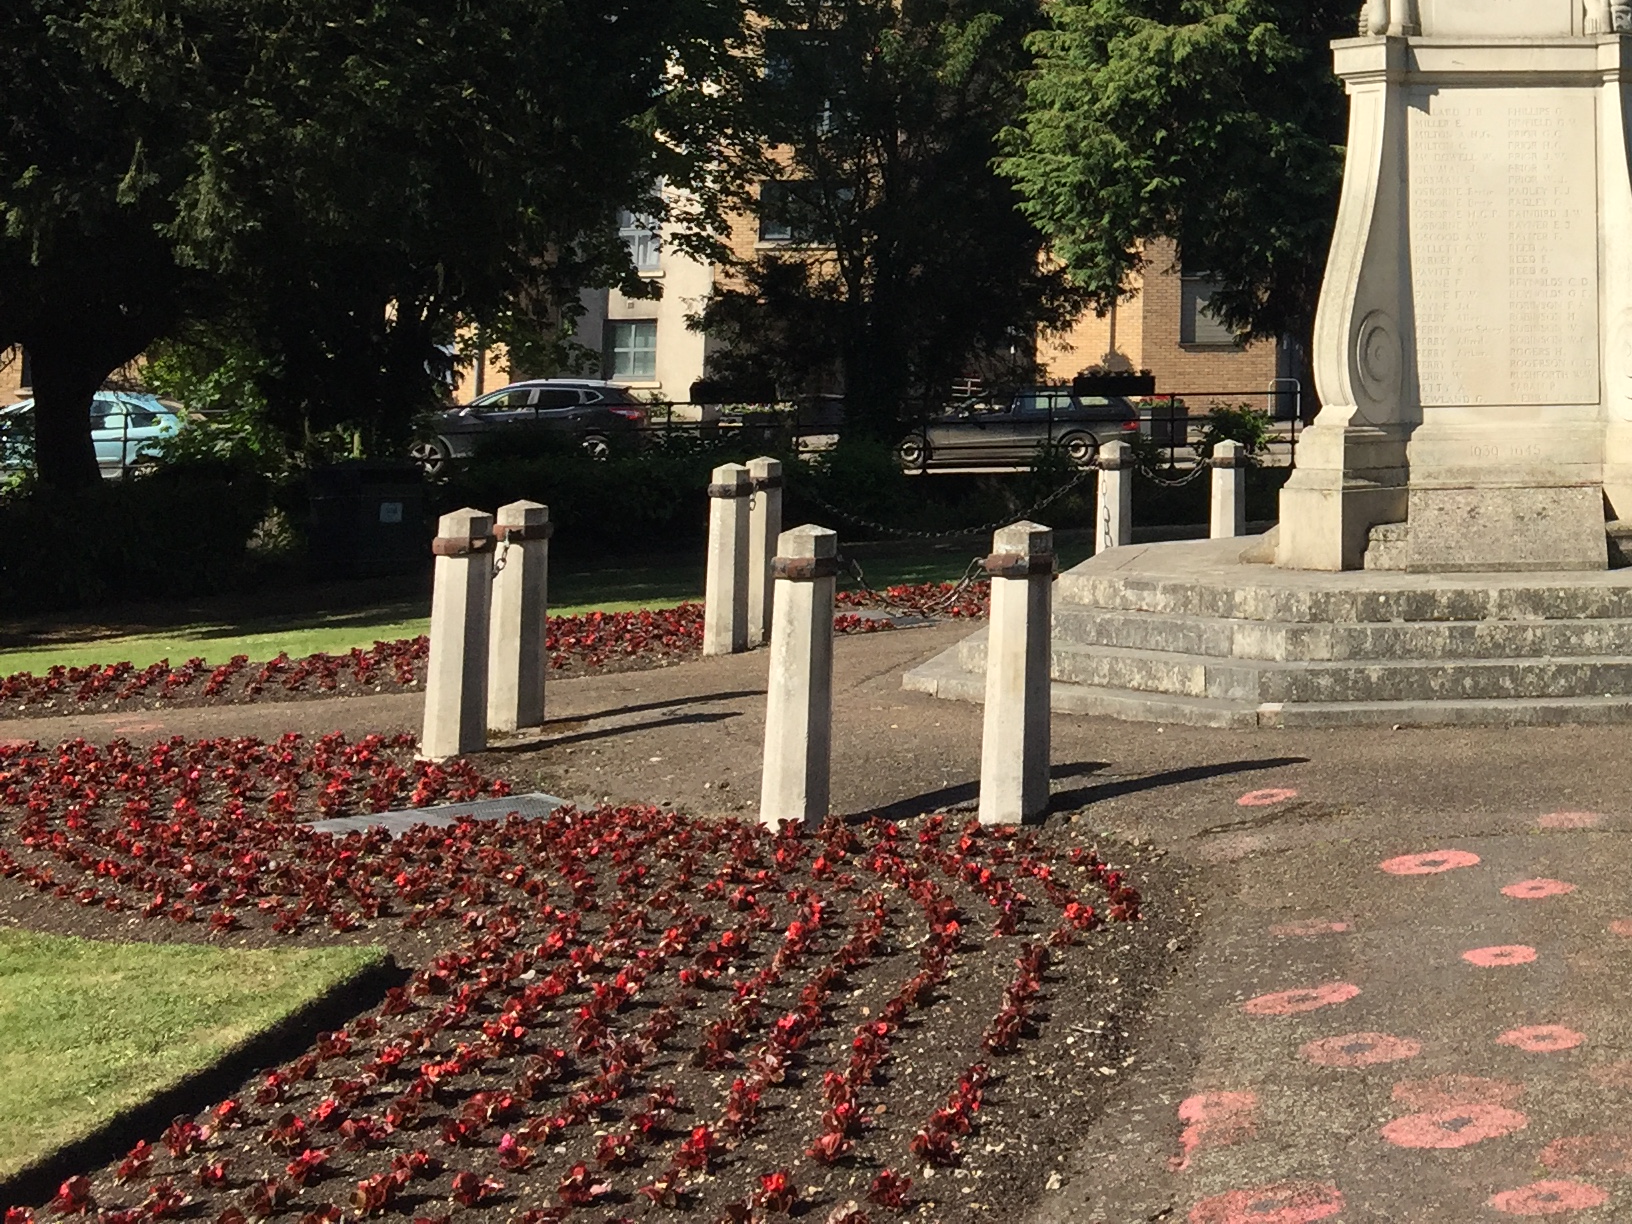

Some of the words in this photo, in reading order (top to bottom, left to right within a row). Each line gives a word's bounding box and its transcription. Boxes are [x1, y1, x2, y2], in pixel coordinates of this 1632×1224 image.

[1418, 371, 1447, 381] ERRY
[1418, 394, 1470, 404] EWLAND
[1470, 444, 1499, 459] 1939
